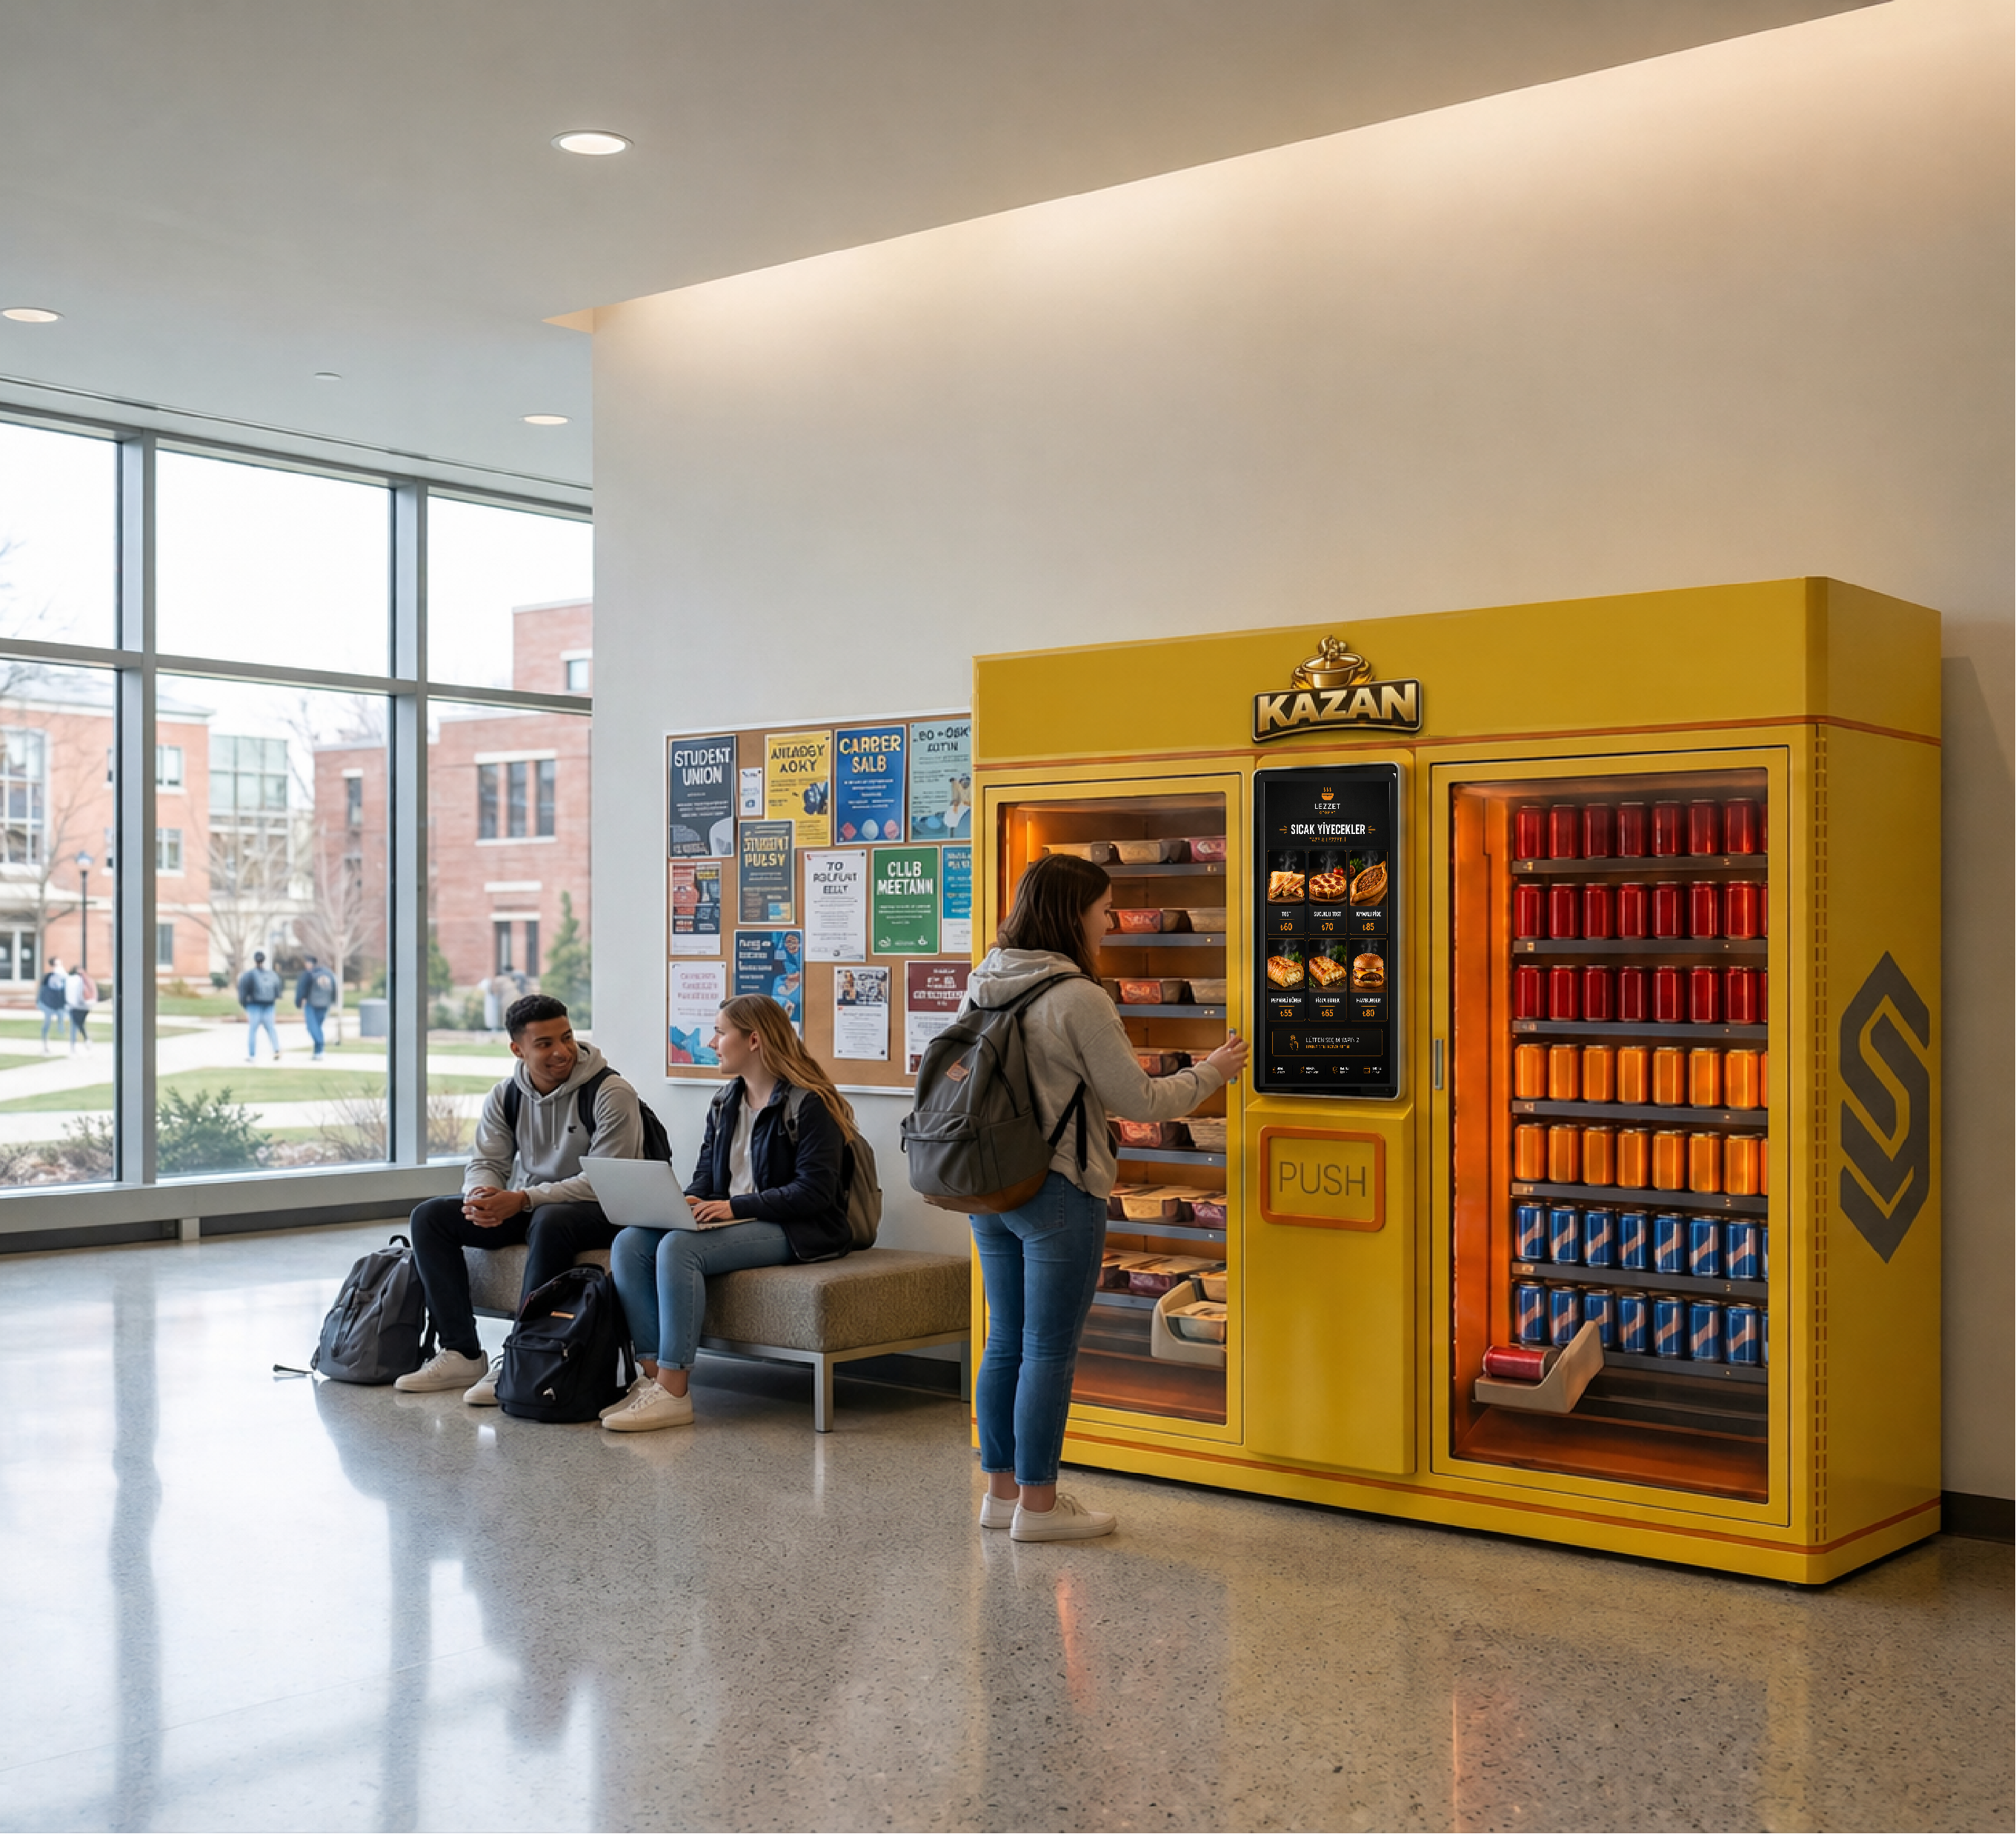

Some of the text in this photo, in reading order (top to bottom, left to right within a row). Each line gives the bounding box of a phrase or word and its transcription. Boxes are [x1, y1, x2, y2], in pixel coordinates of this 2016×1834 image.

[1257, 683, 1417, 733] KAZAN
[674, 747, 731, 767] STUDENT
[682, 766, 722, 785] UNION
[1291, 821, 1365, 835] SICAK YİYECEKLER
[1279, 1161, 1365, 1197] PUSH
